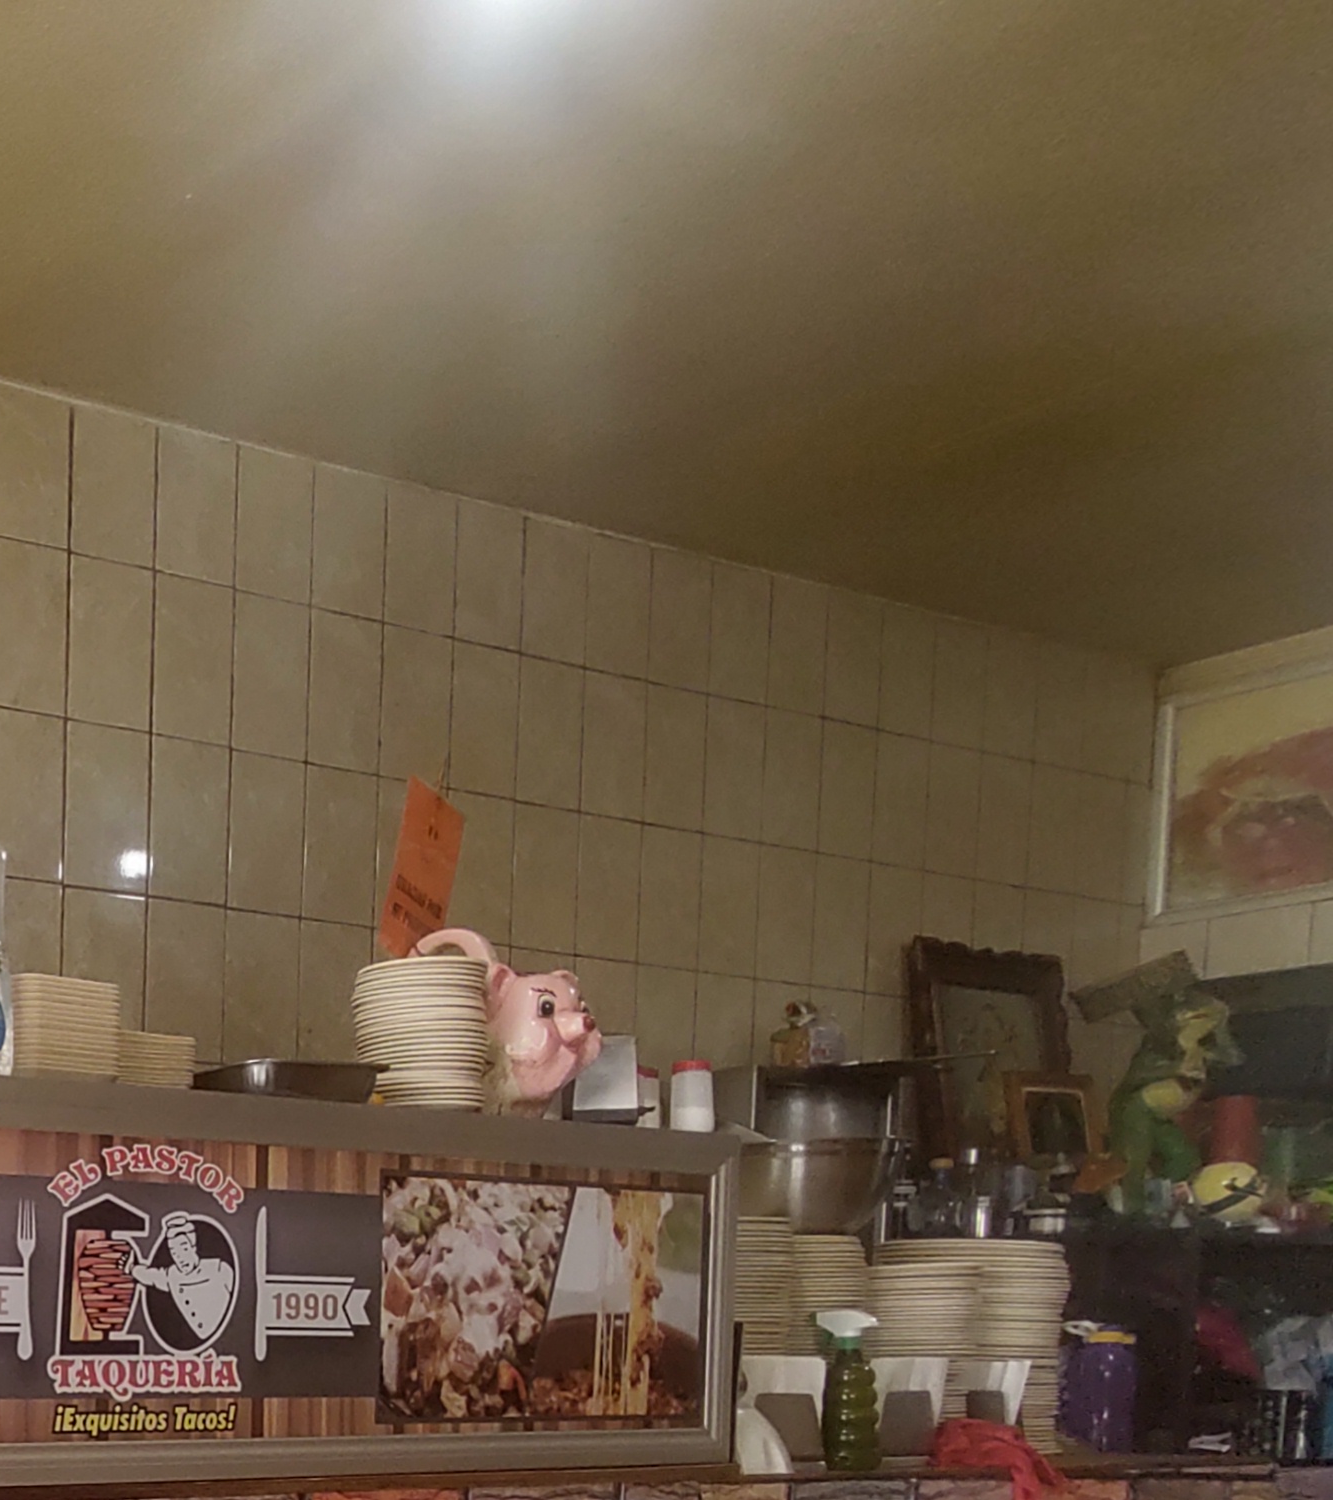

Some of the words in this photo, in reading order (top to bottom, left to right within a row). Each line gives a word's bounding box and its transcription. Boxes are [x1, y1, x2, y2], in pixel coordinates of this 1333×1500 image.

[48, 1160, 100, 1205] EL
[103, 1145, 243, 1212] PASTOR
[272, 1293, 338, 1320] 1990
[50, 1352, 239, 1397] TAQUERÍA
[54, 1405, 169, 1436] ¡Exquisitos
[174, 1404, 237, 1431] Tacos!
